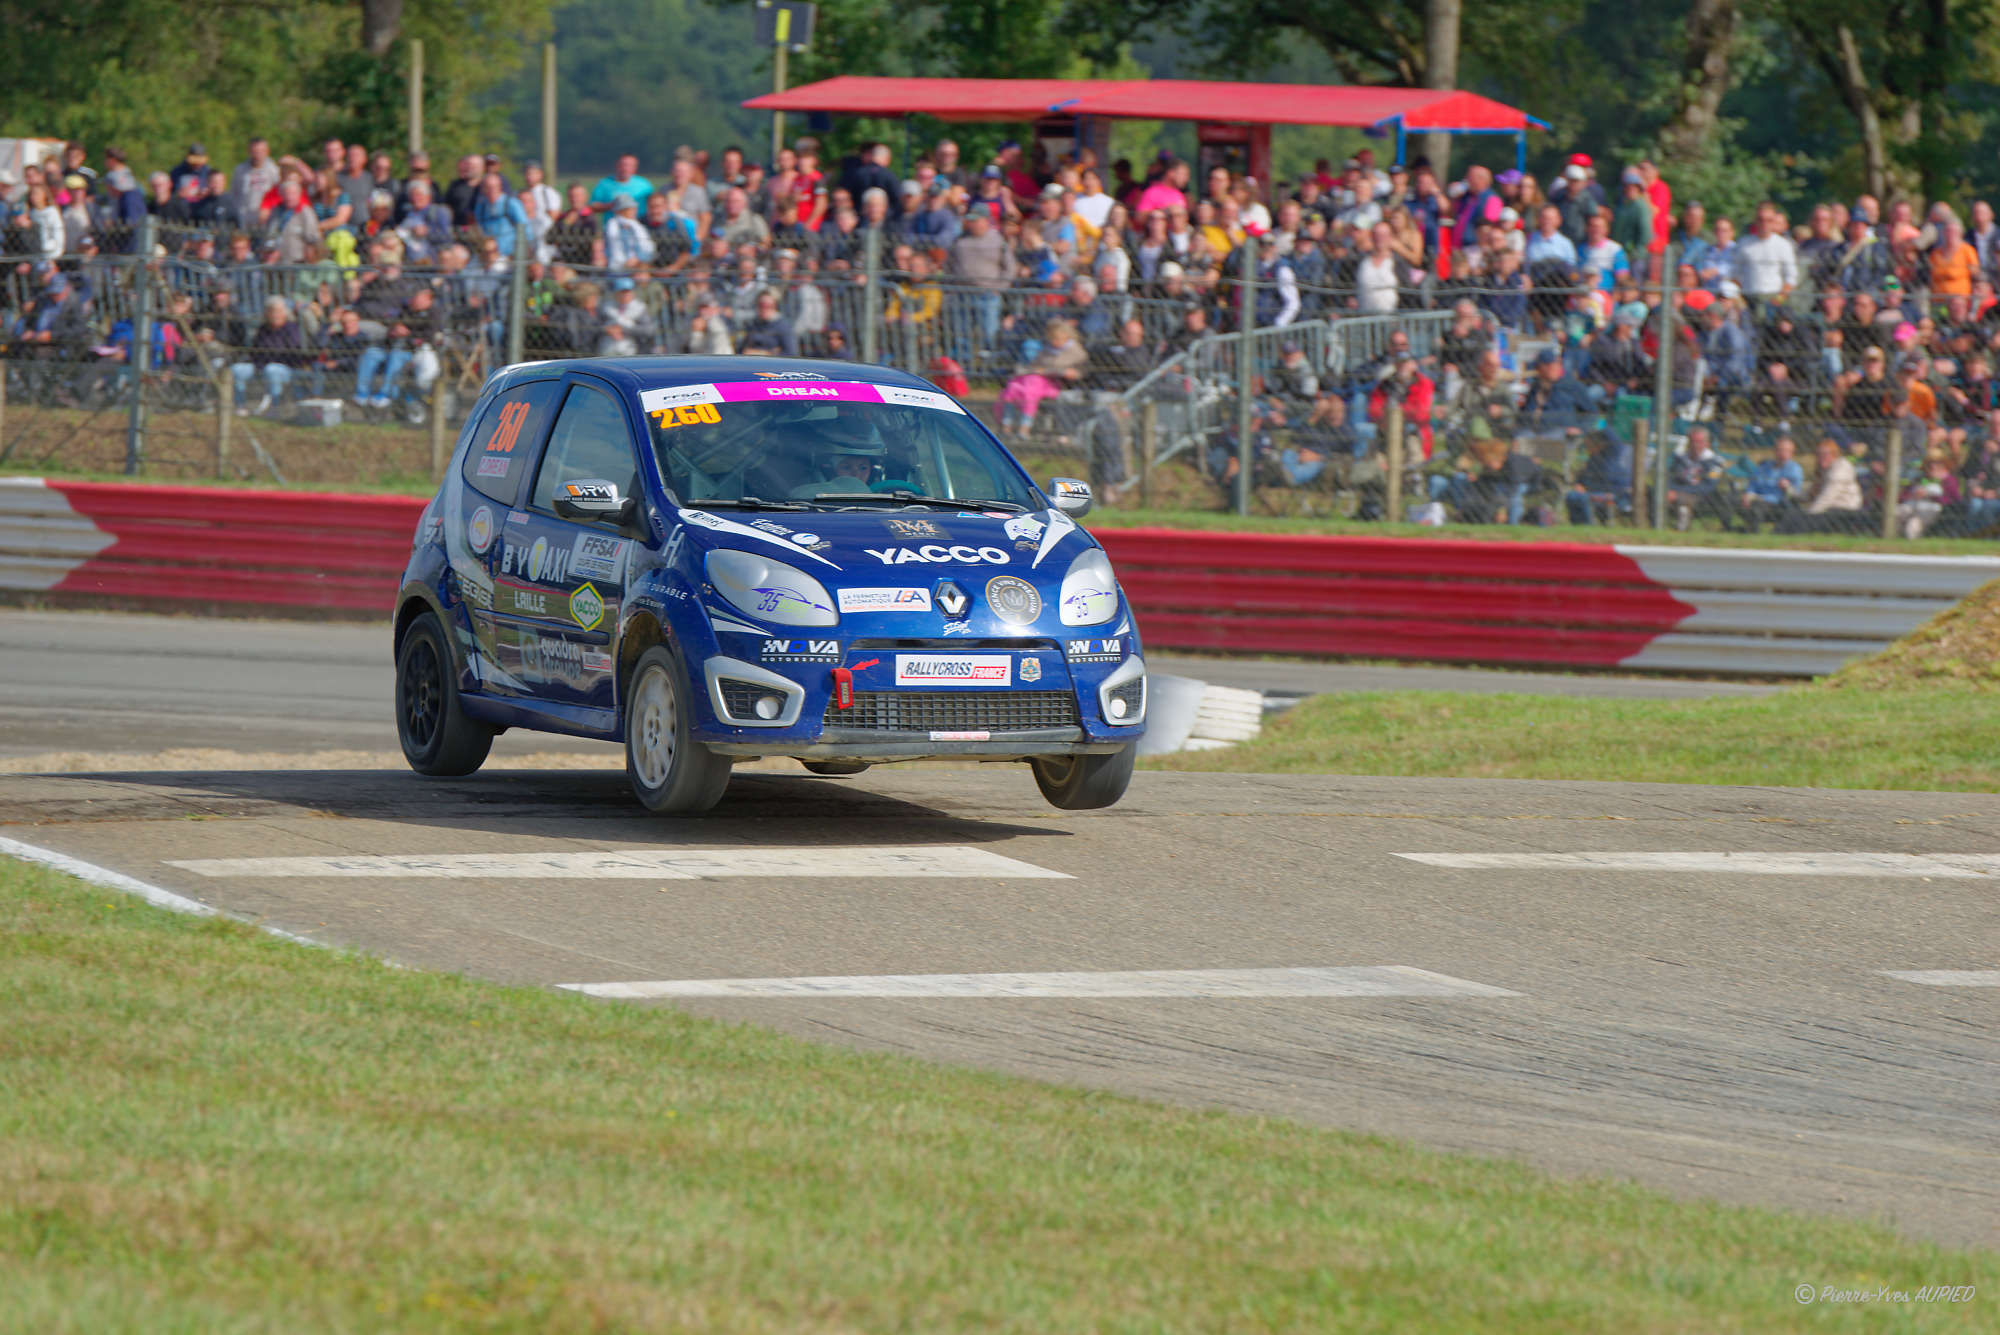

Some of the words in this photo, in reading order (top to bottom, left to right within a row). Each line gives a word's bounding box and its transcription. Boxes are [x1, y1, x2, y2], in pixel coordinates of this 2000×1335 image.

[767, 387, 839, 396] DREAN
[651, 403, 721, 429] 260
[486, 401, 530, 453] 260
[582, 537, 616, 557] FFSA
[864, 545, 1011, 565] YACCO
[514, 591, 546, 613] LAILLE
[575, 598, 600, 616] YACCO
[757, 592, 784, 612] 35
[762, 640, 839, 653] NOVA
[1068, 640, 1120, 654] NOVA
[905, 662, 972, 676] RALLYCROSS
[974, 667, 1006, 679] FRANCE
